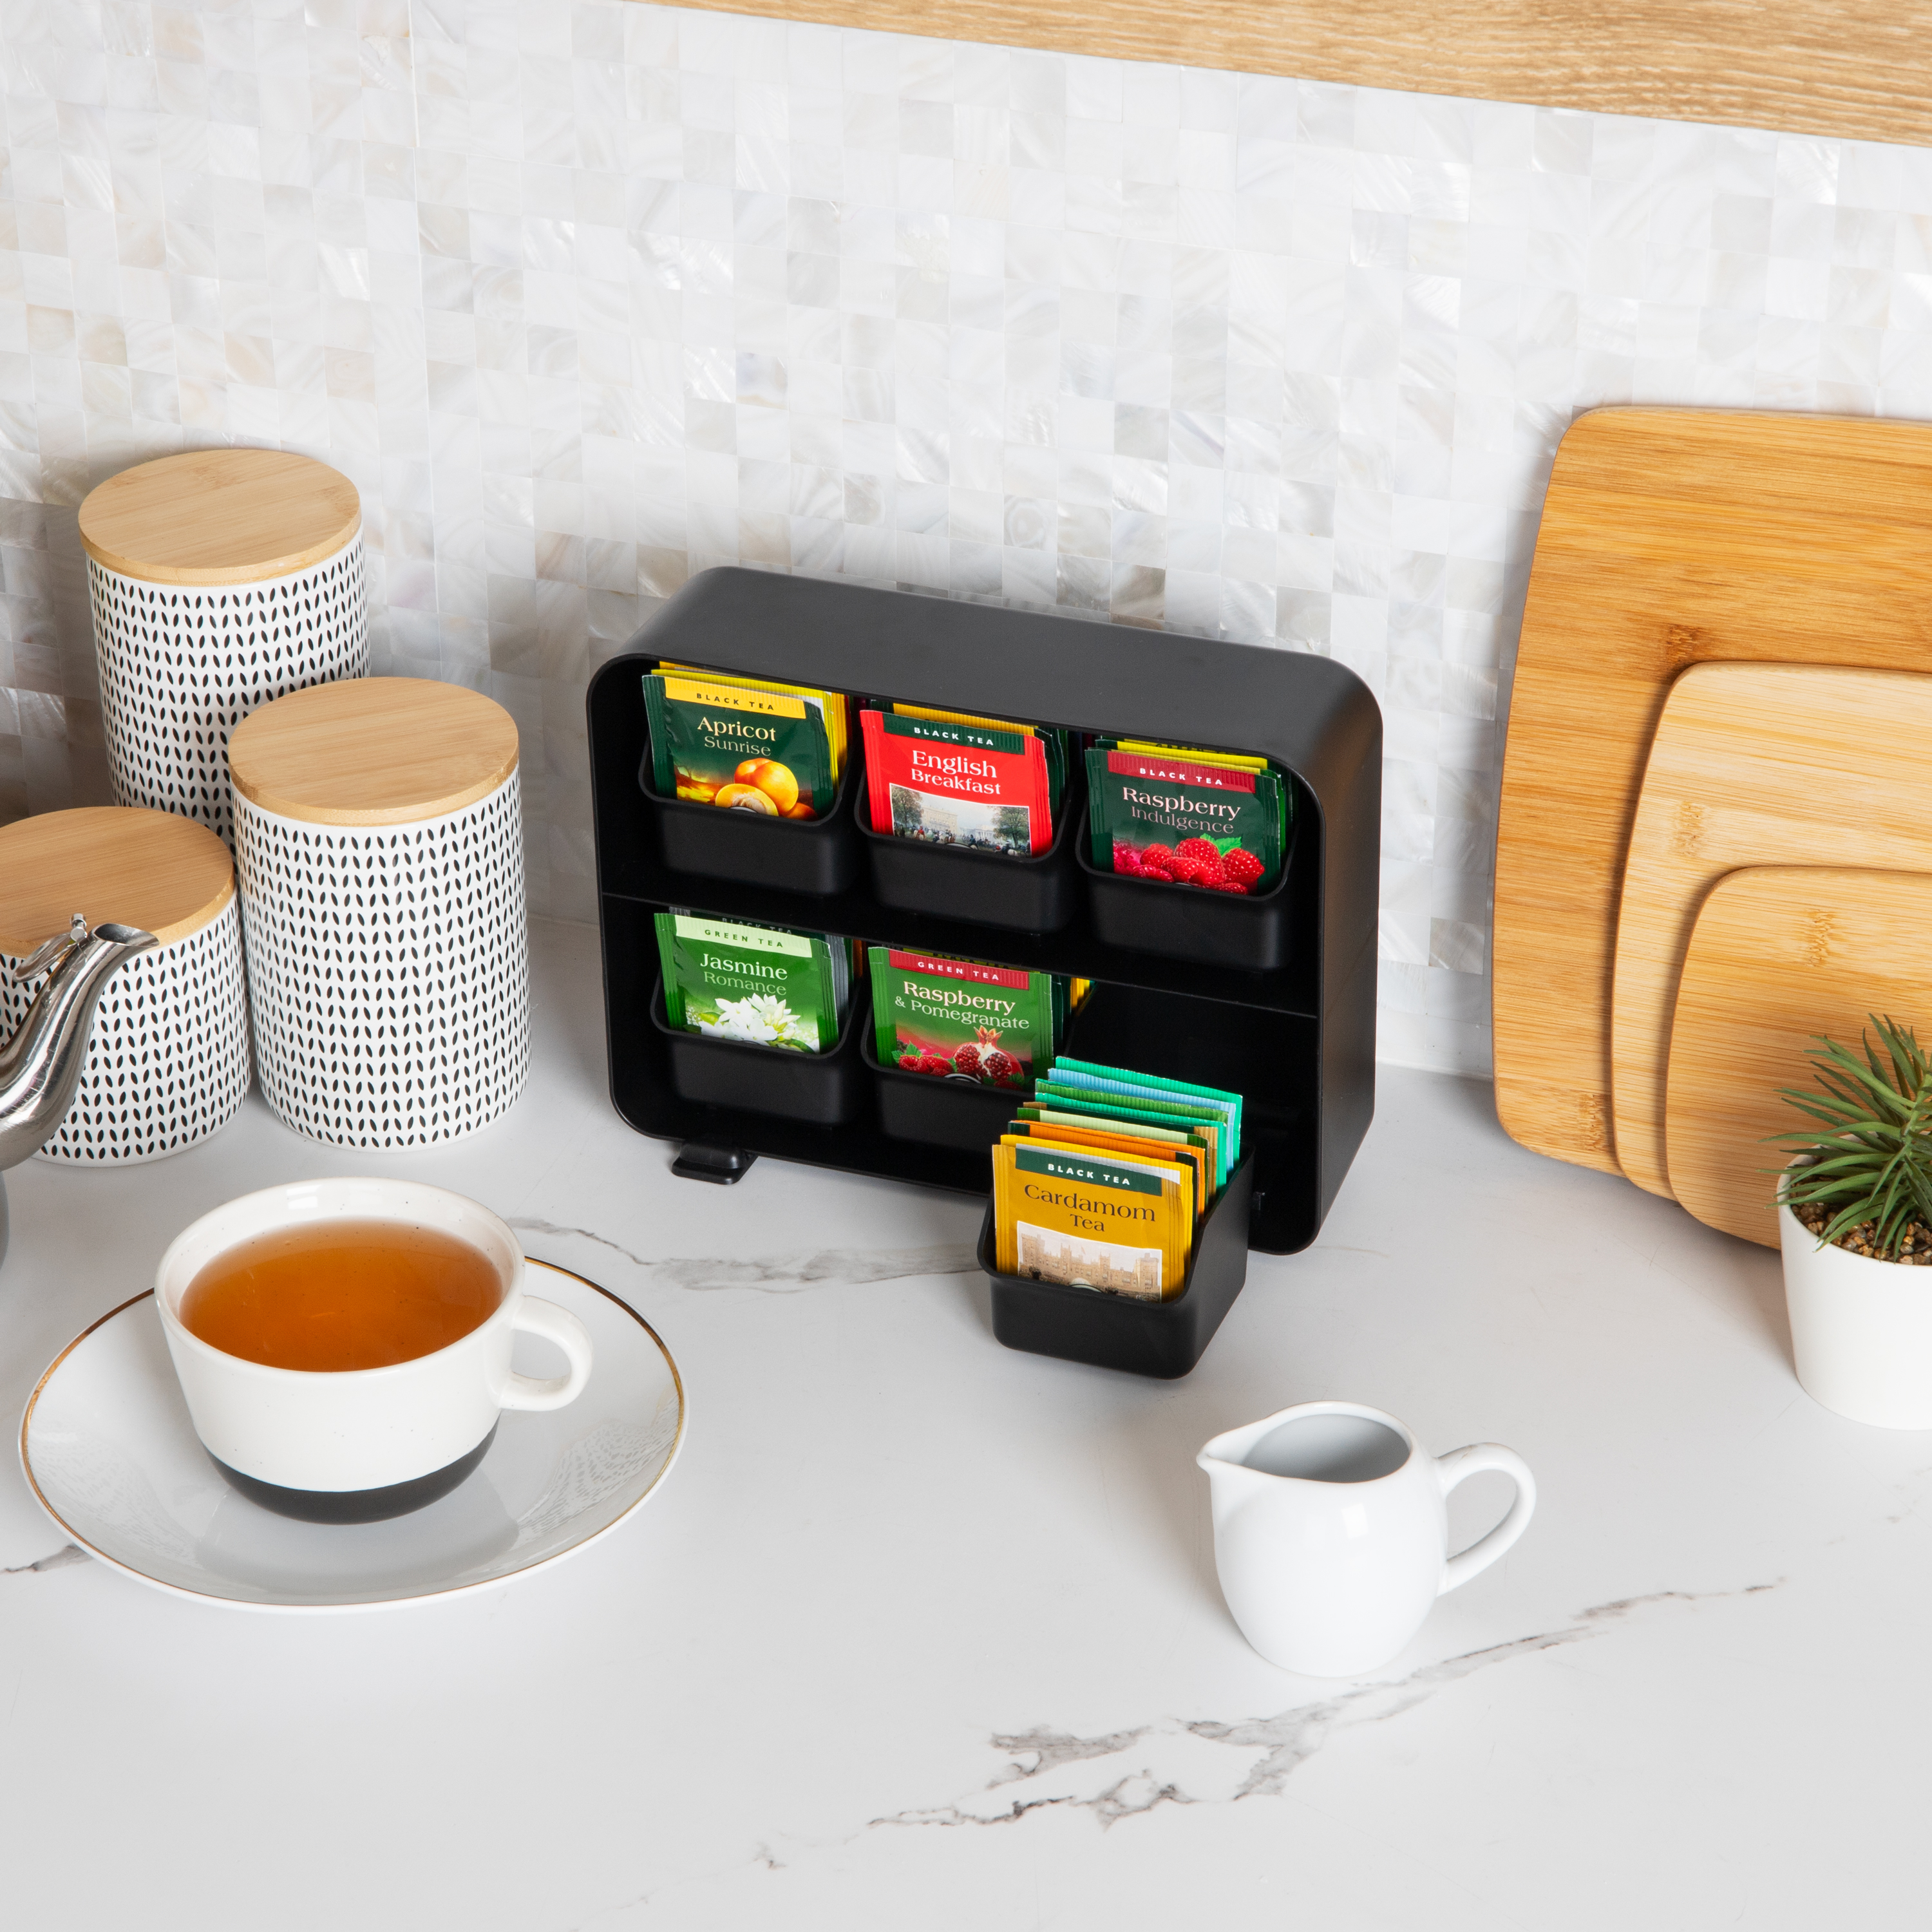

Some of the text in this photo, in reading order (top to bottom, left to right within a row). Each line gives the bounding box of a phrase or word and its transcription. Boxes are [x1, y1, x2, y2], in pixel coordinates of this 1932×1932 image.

[697, 693, 774, 710] BLACK TEA
[697, 717, 776, 741] Apricot
[914, 727, 994, 746] BLACK TEA
[704, 735, 772, 757] Sunrise
[912, 750, 997, 778] English
[911, 768, 1001, 795] Breakfast
[1140, 768, 1222, 786] BLACK TEA
[1122, 787, 1241, 821] Raspberry
[1132, 806, 1234, 834] Indulgence
[705, 929, 783, 948] GREEN TEA
[700, 953, 788, 980] Jasmine
[918, 961, 999, 980] GREEN TEA
[703, 971, 787, 996] Romance
[904, 981, 1016, 1016] Raspberry
[895, 996, 1030, 1029] & Pomegranate
[1048, 1163, 1130, 1186] BLACK TEA
[1024, 1184, 1156, 1222] Cardamom
[1069, 1213, 1105, 1232] Tea
